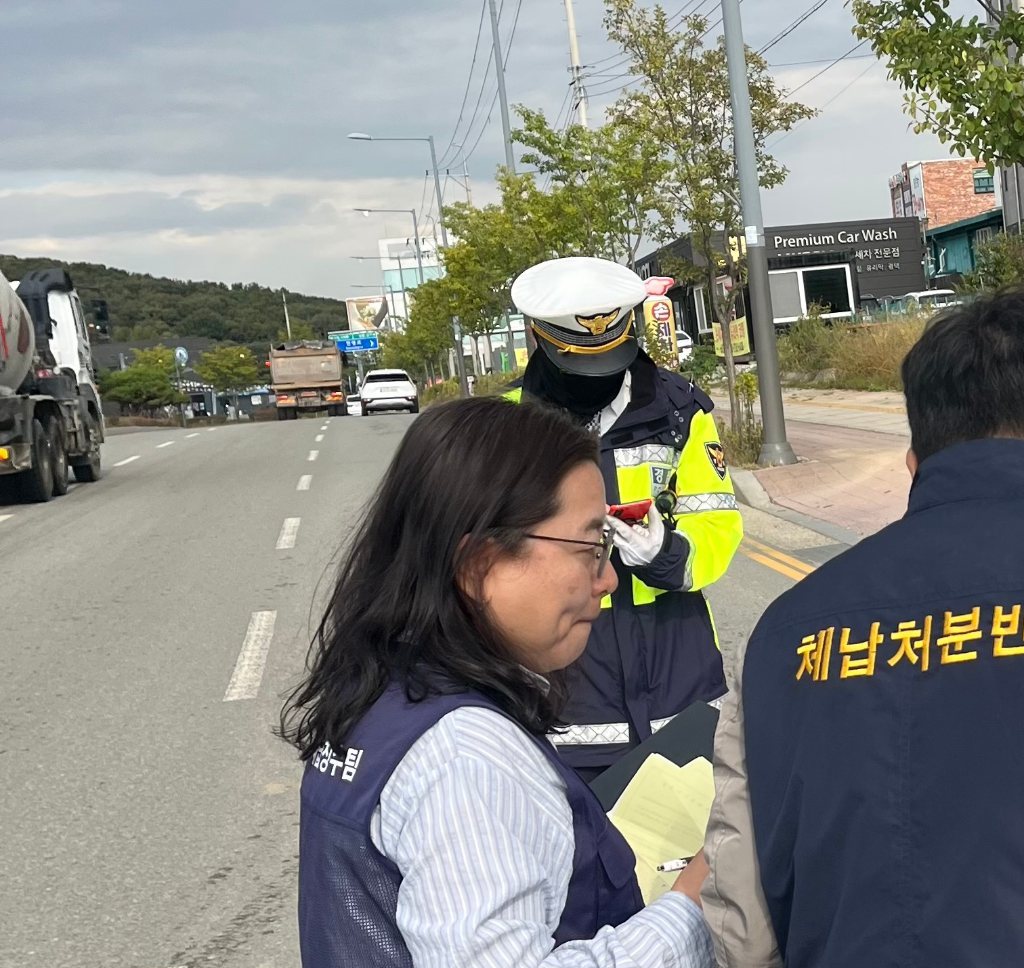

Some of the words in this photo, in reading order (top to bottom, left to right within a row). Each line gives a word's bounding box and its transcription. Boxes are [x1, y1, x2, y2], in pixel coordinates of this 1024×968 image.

[774, 233, 834, 248] Premium
[838, 231, 859, 243] Car
[861, 227, 897, 241] Wash
[873, 247, 900, 259] 전문점
